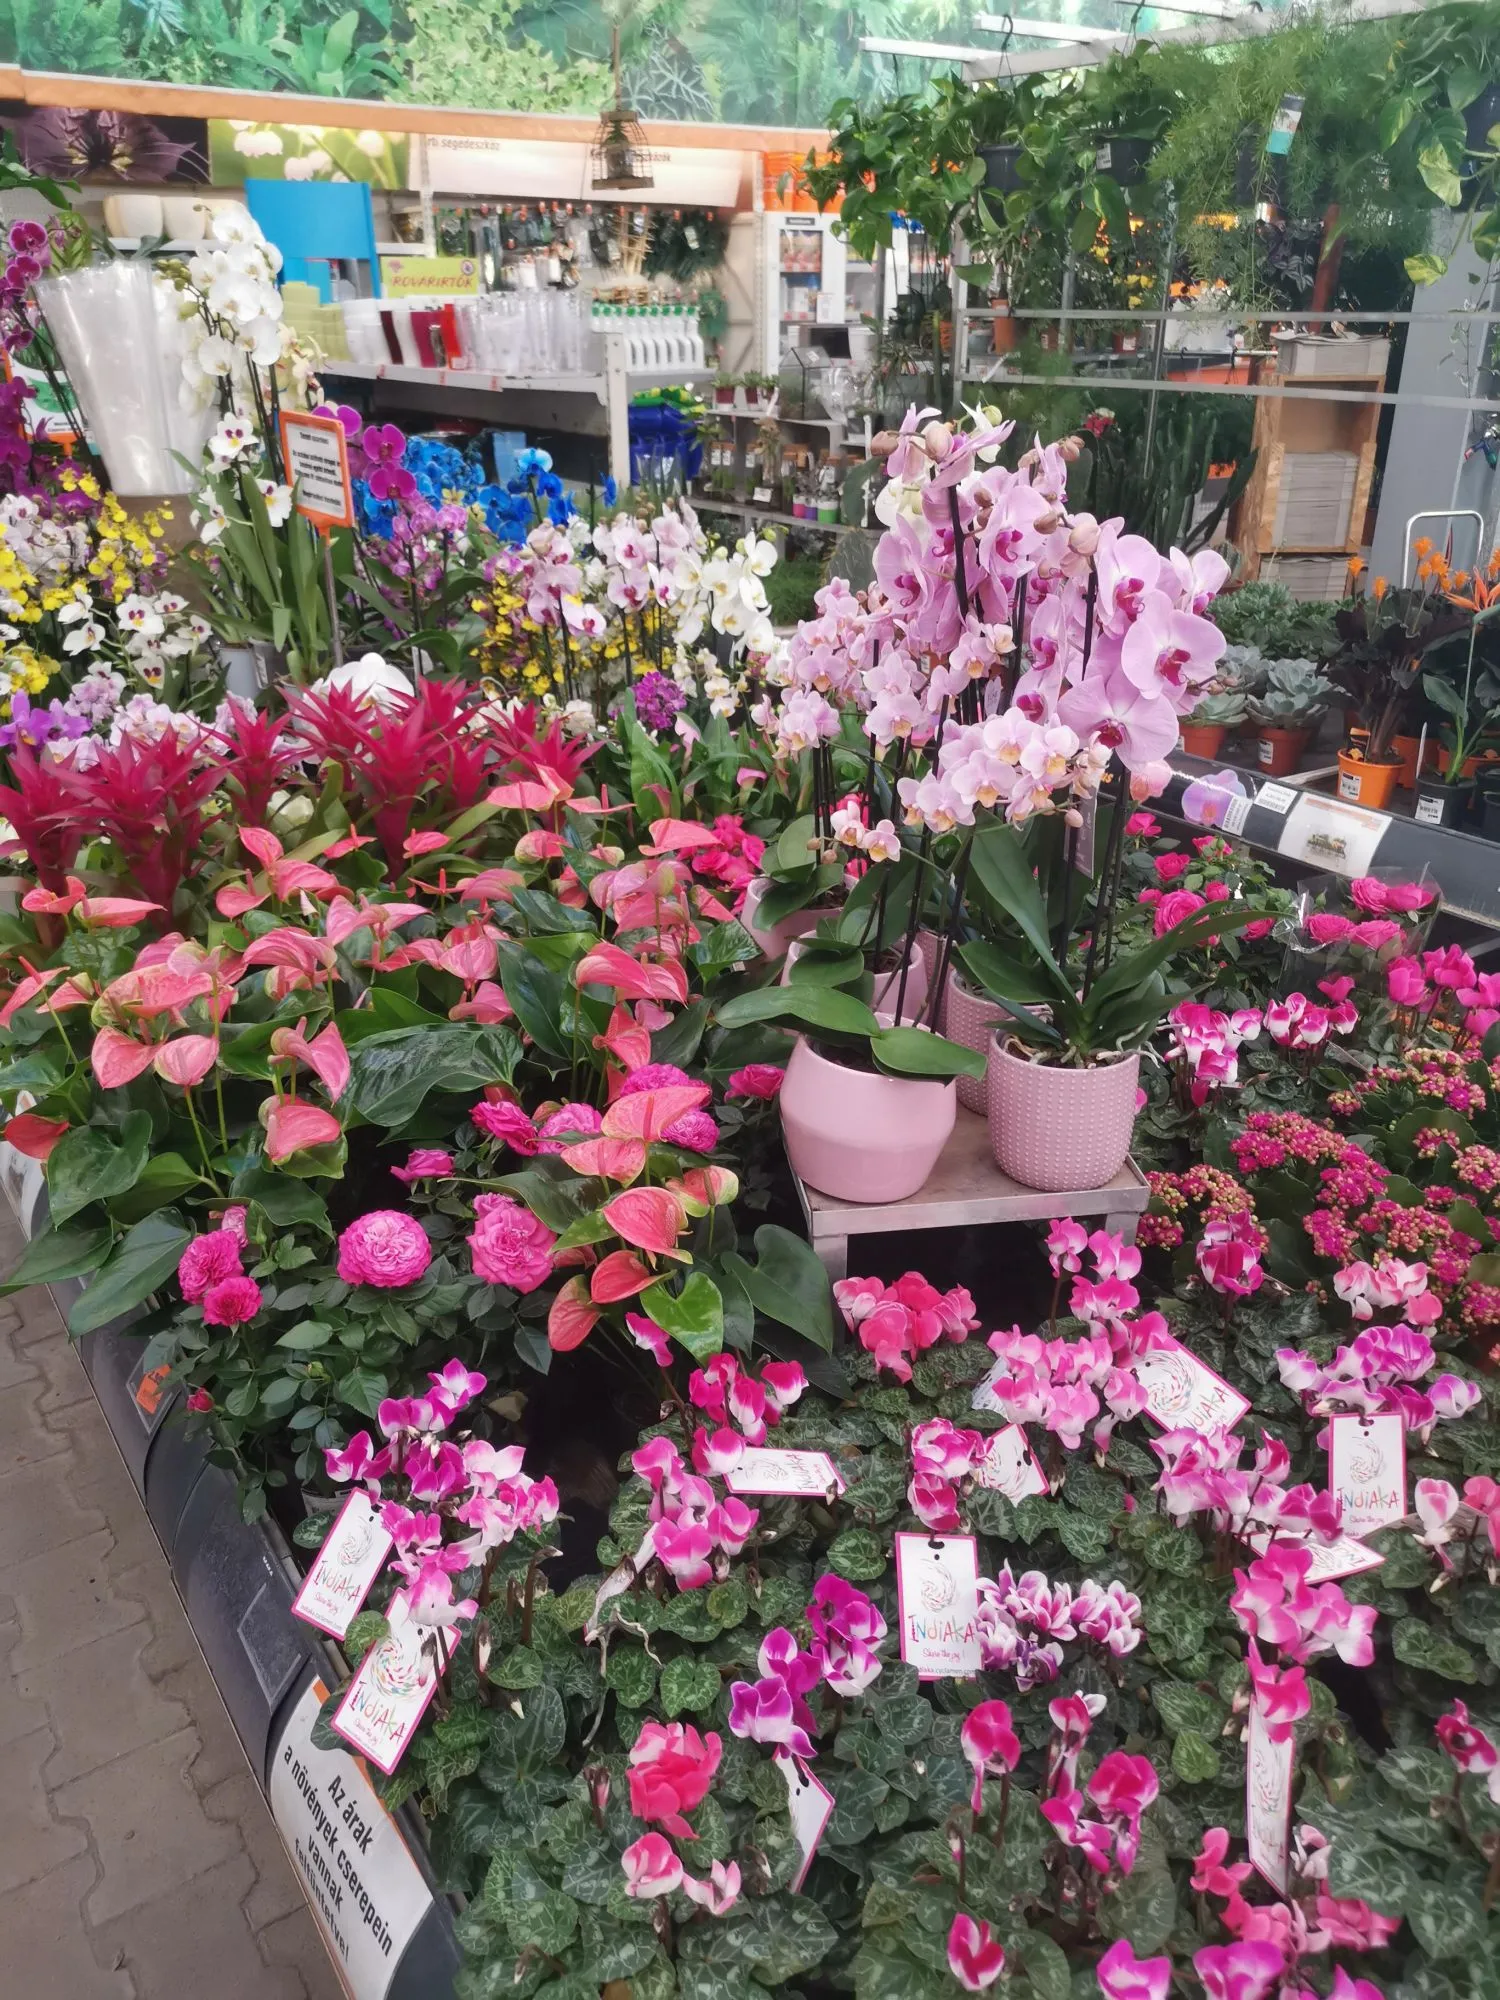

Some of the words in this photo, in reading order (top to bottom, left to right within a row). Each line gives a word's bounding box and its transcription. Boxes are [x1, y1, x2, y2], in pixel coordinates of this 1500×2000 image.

[284, 1744, 293, 1765] a
[291, 1759, 339, 1855] növények
[336, 1849, 394, 1958] cserepein
[327, 1774, 346, 1808] Az
[342, 1800, 374, 1856] árak
[308, 1834, 344, 1914] vannak
